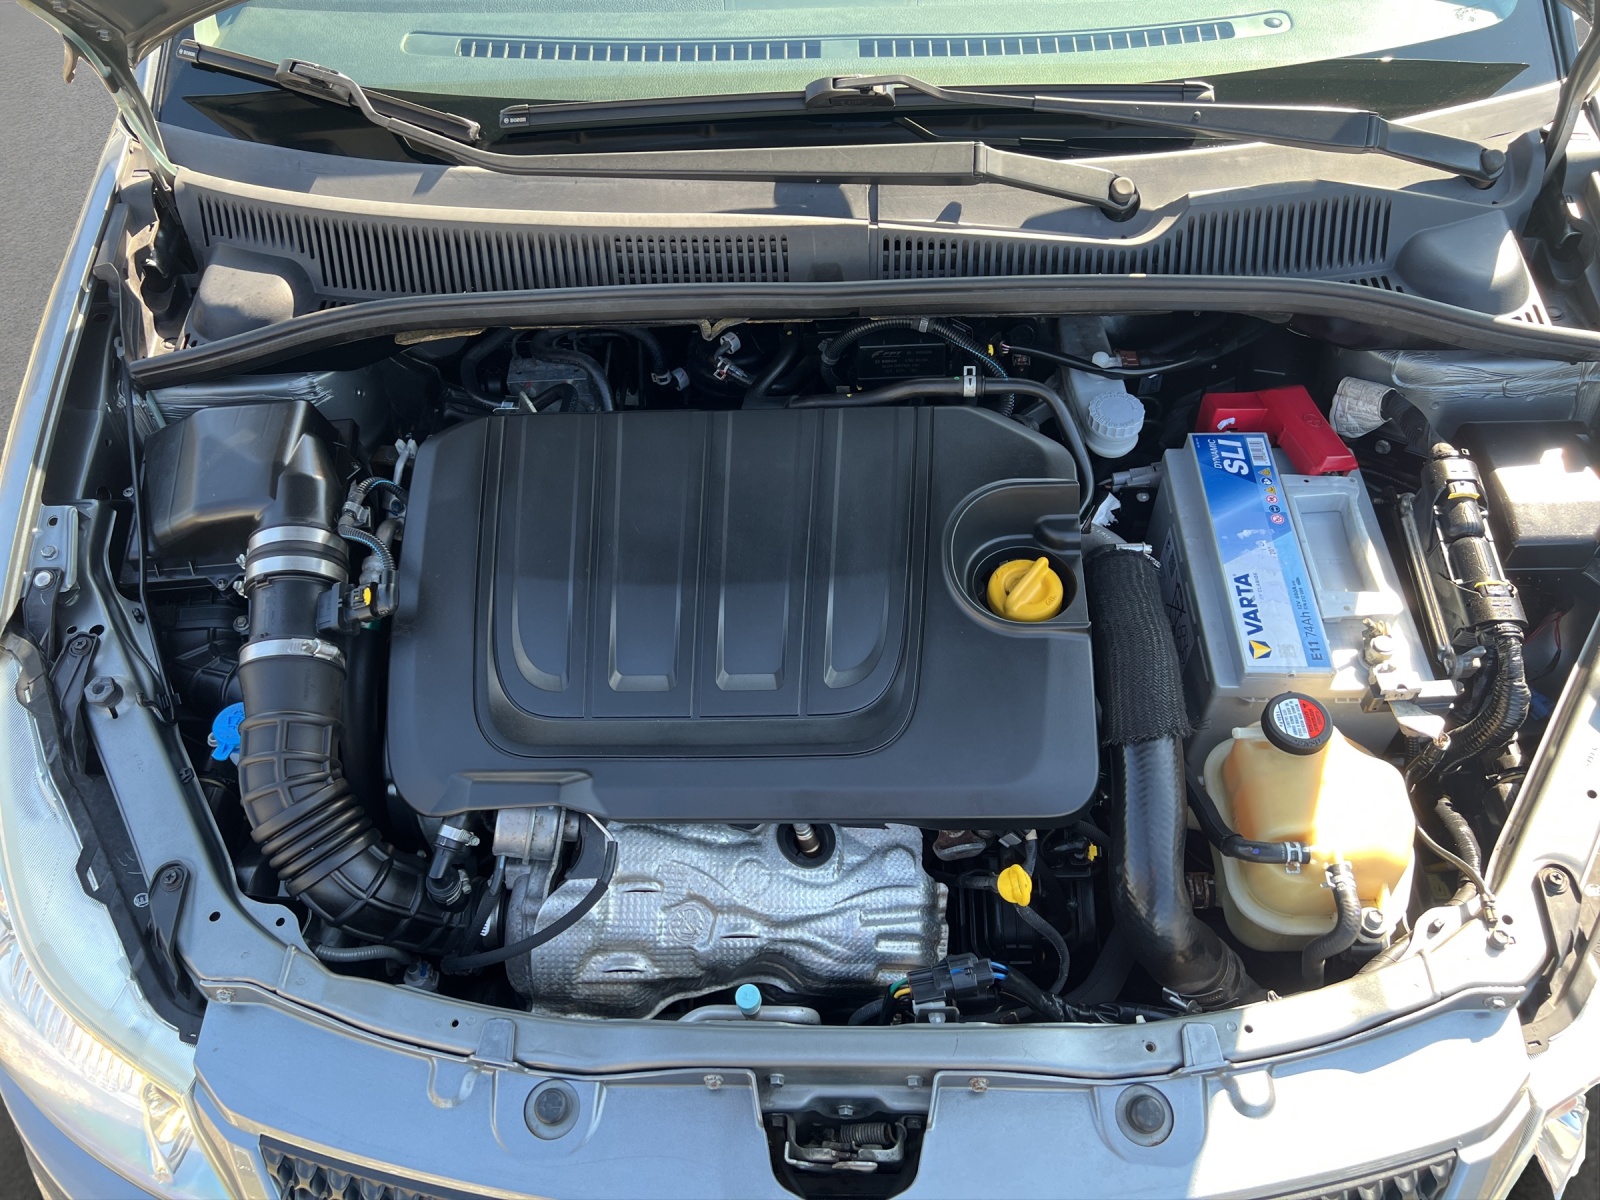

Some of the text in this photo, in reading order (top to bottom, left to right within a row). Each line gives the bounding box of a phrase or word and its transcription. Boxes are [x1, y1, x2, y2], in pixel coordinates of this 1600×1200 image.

[1207, 438, 1223, 469] DYNAMIC
[1217, 438, 1249, 475] SLI
[1233, 573, 1264, 636] VARTA
[1301, 612, 1323, 661] E11 74Ah
